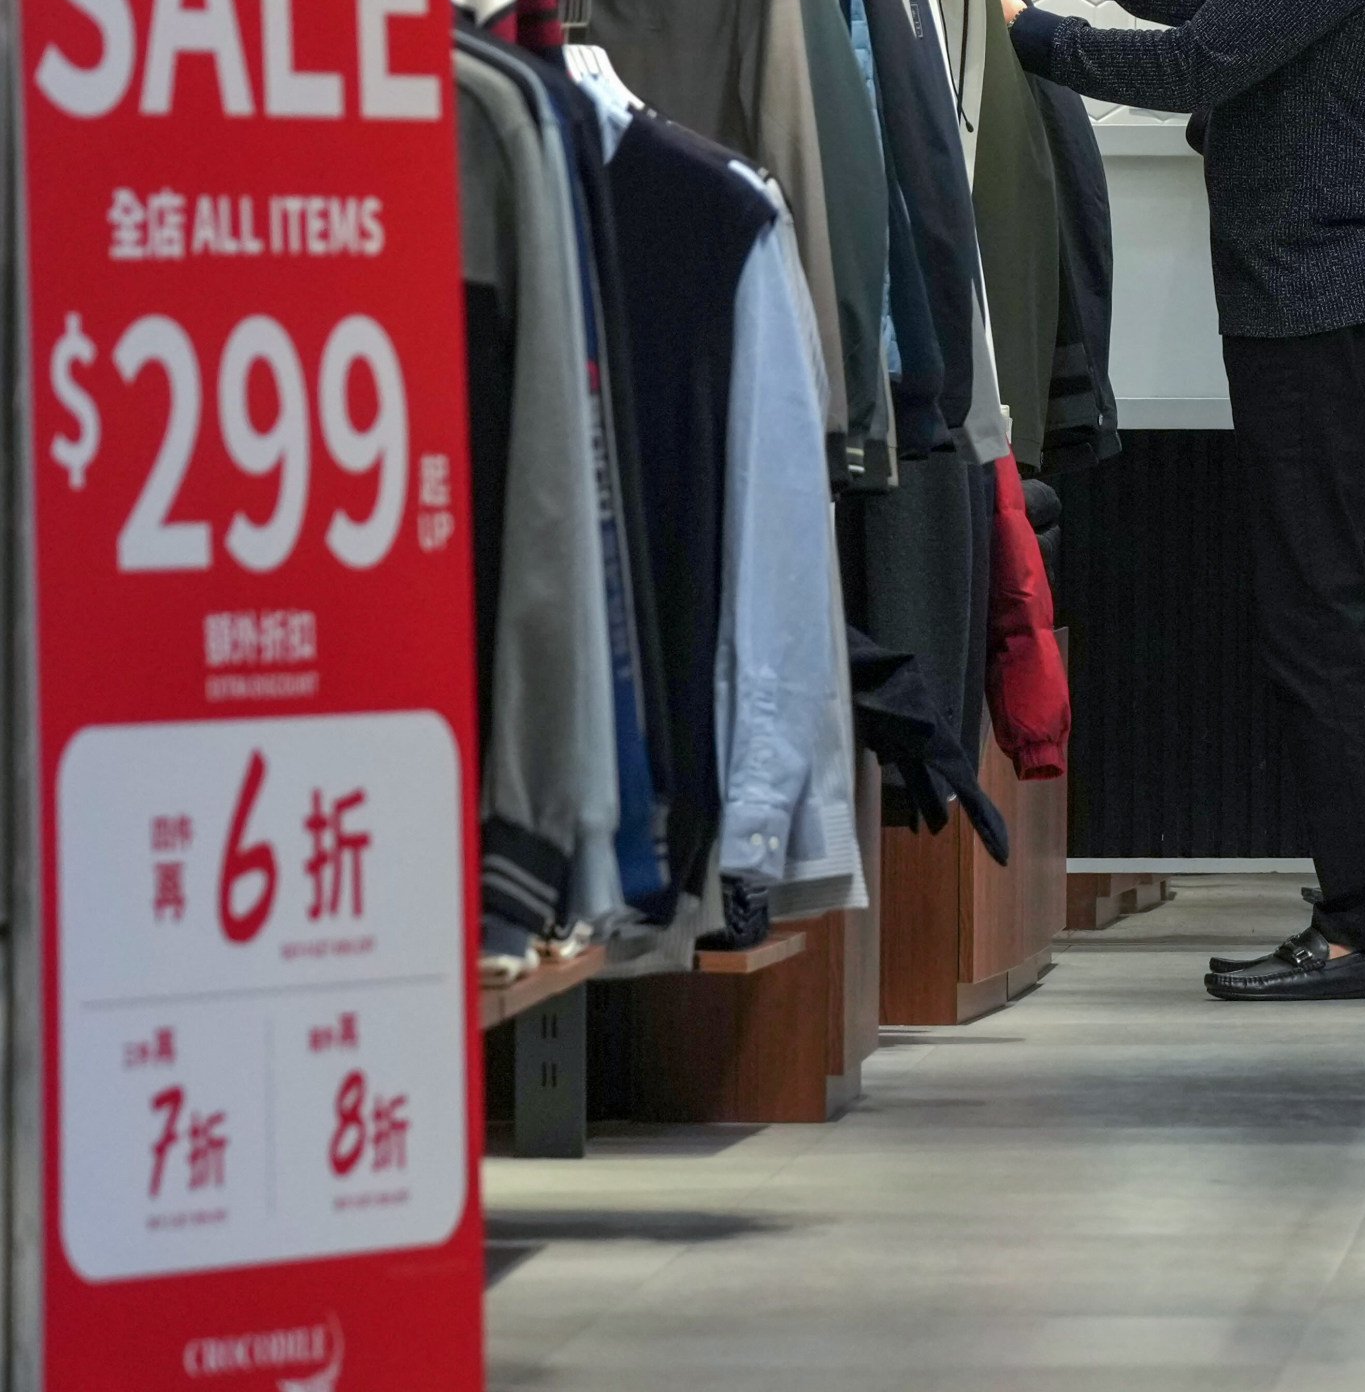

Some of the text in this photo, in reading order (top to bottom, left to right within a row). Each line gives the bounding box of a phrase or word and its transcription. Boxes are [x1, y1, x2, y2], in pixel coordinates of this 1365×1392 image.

[107, 188, 385, 260] 全店 ALL ITEMS
[51, 312, 409, 572] $299
[417, 511, 455, 551] UP
